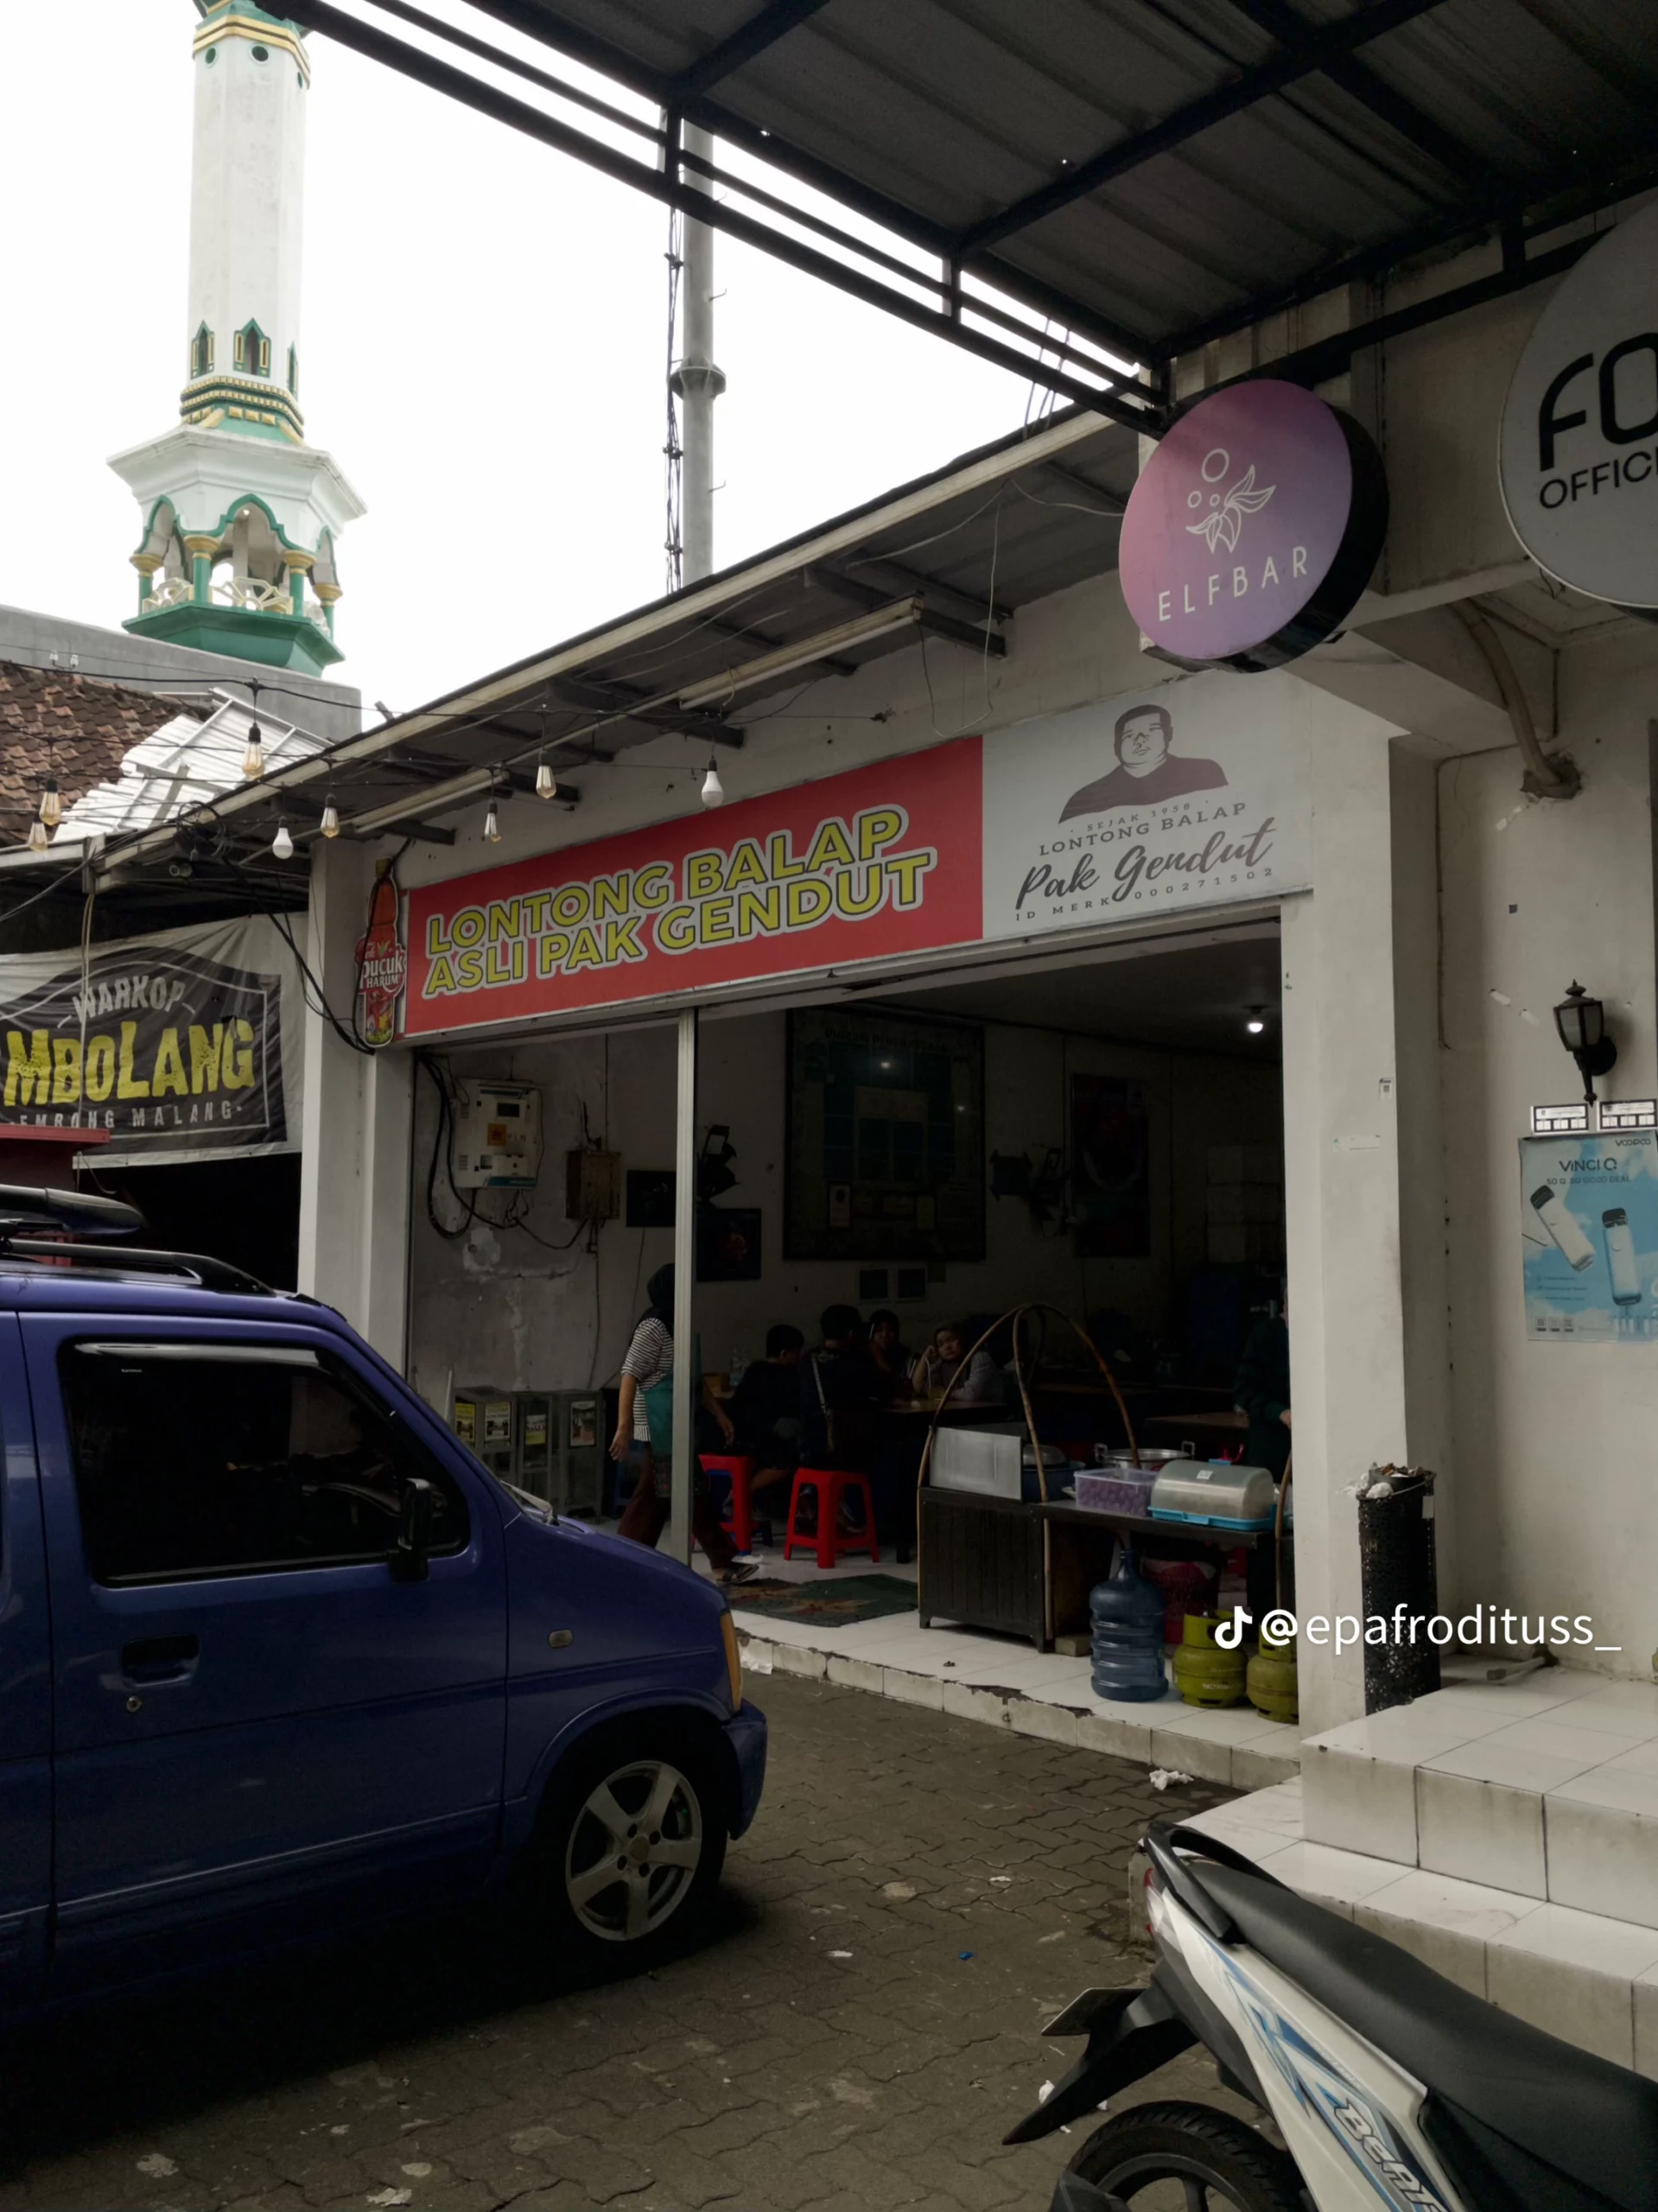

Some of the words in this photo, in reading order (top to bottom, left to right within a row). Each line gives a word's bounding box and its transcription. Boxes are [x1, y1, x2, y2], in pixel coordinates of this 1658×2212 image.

[1158, 545, 1307, 622] ELFBAR
[1039, 823, 1150, 856] LONTONG
[1160, 803, 1247, 831] BALAP
[1087, 813, 1139, 831] SEJAK
[429, 865, 669, 956] LONTONG
[689, 809, 903, 899] BALAP
[1015, 853, 1100, 910] Pak
[1111, 817, 1278, 903] Gendut
[425, 942, 523, 996] ASLI
[540, 916, 641, 975] PAK
[658, 853, 931, 950] GENDUT
[1015, 912, 1036, 921] ID
[1052, 897, 1110, 915] MERK
[72, 975, 186, 1023] WARKOP
[366, 974, 400, 988] HARUM
[131, 1100, 232, 1128] MALANG
